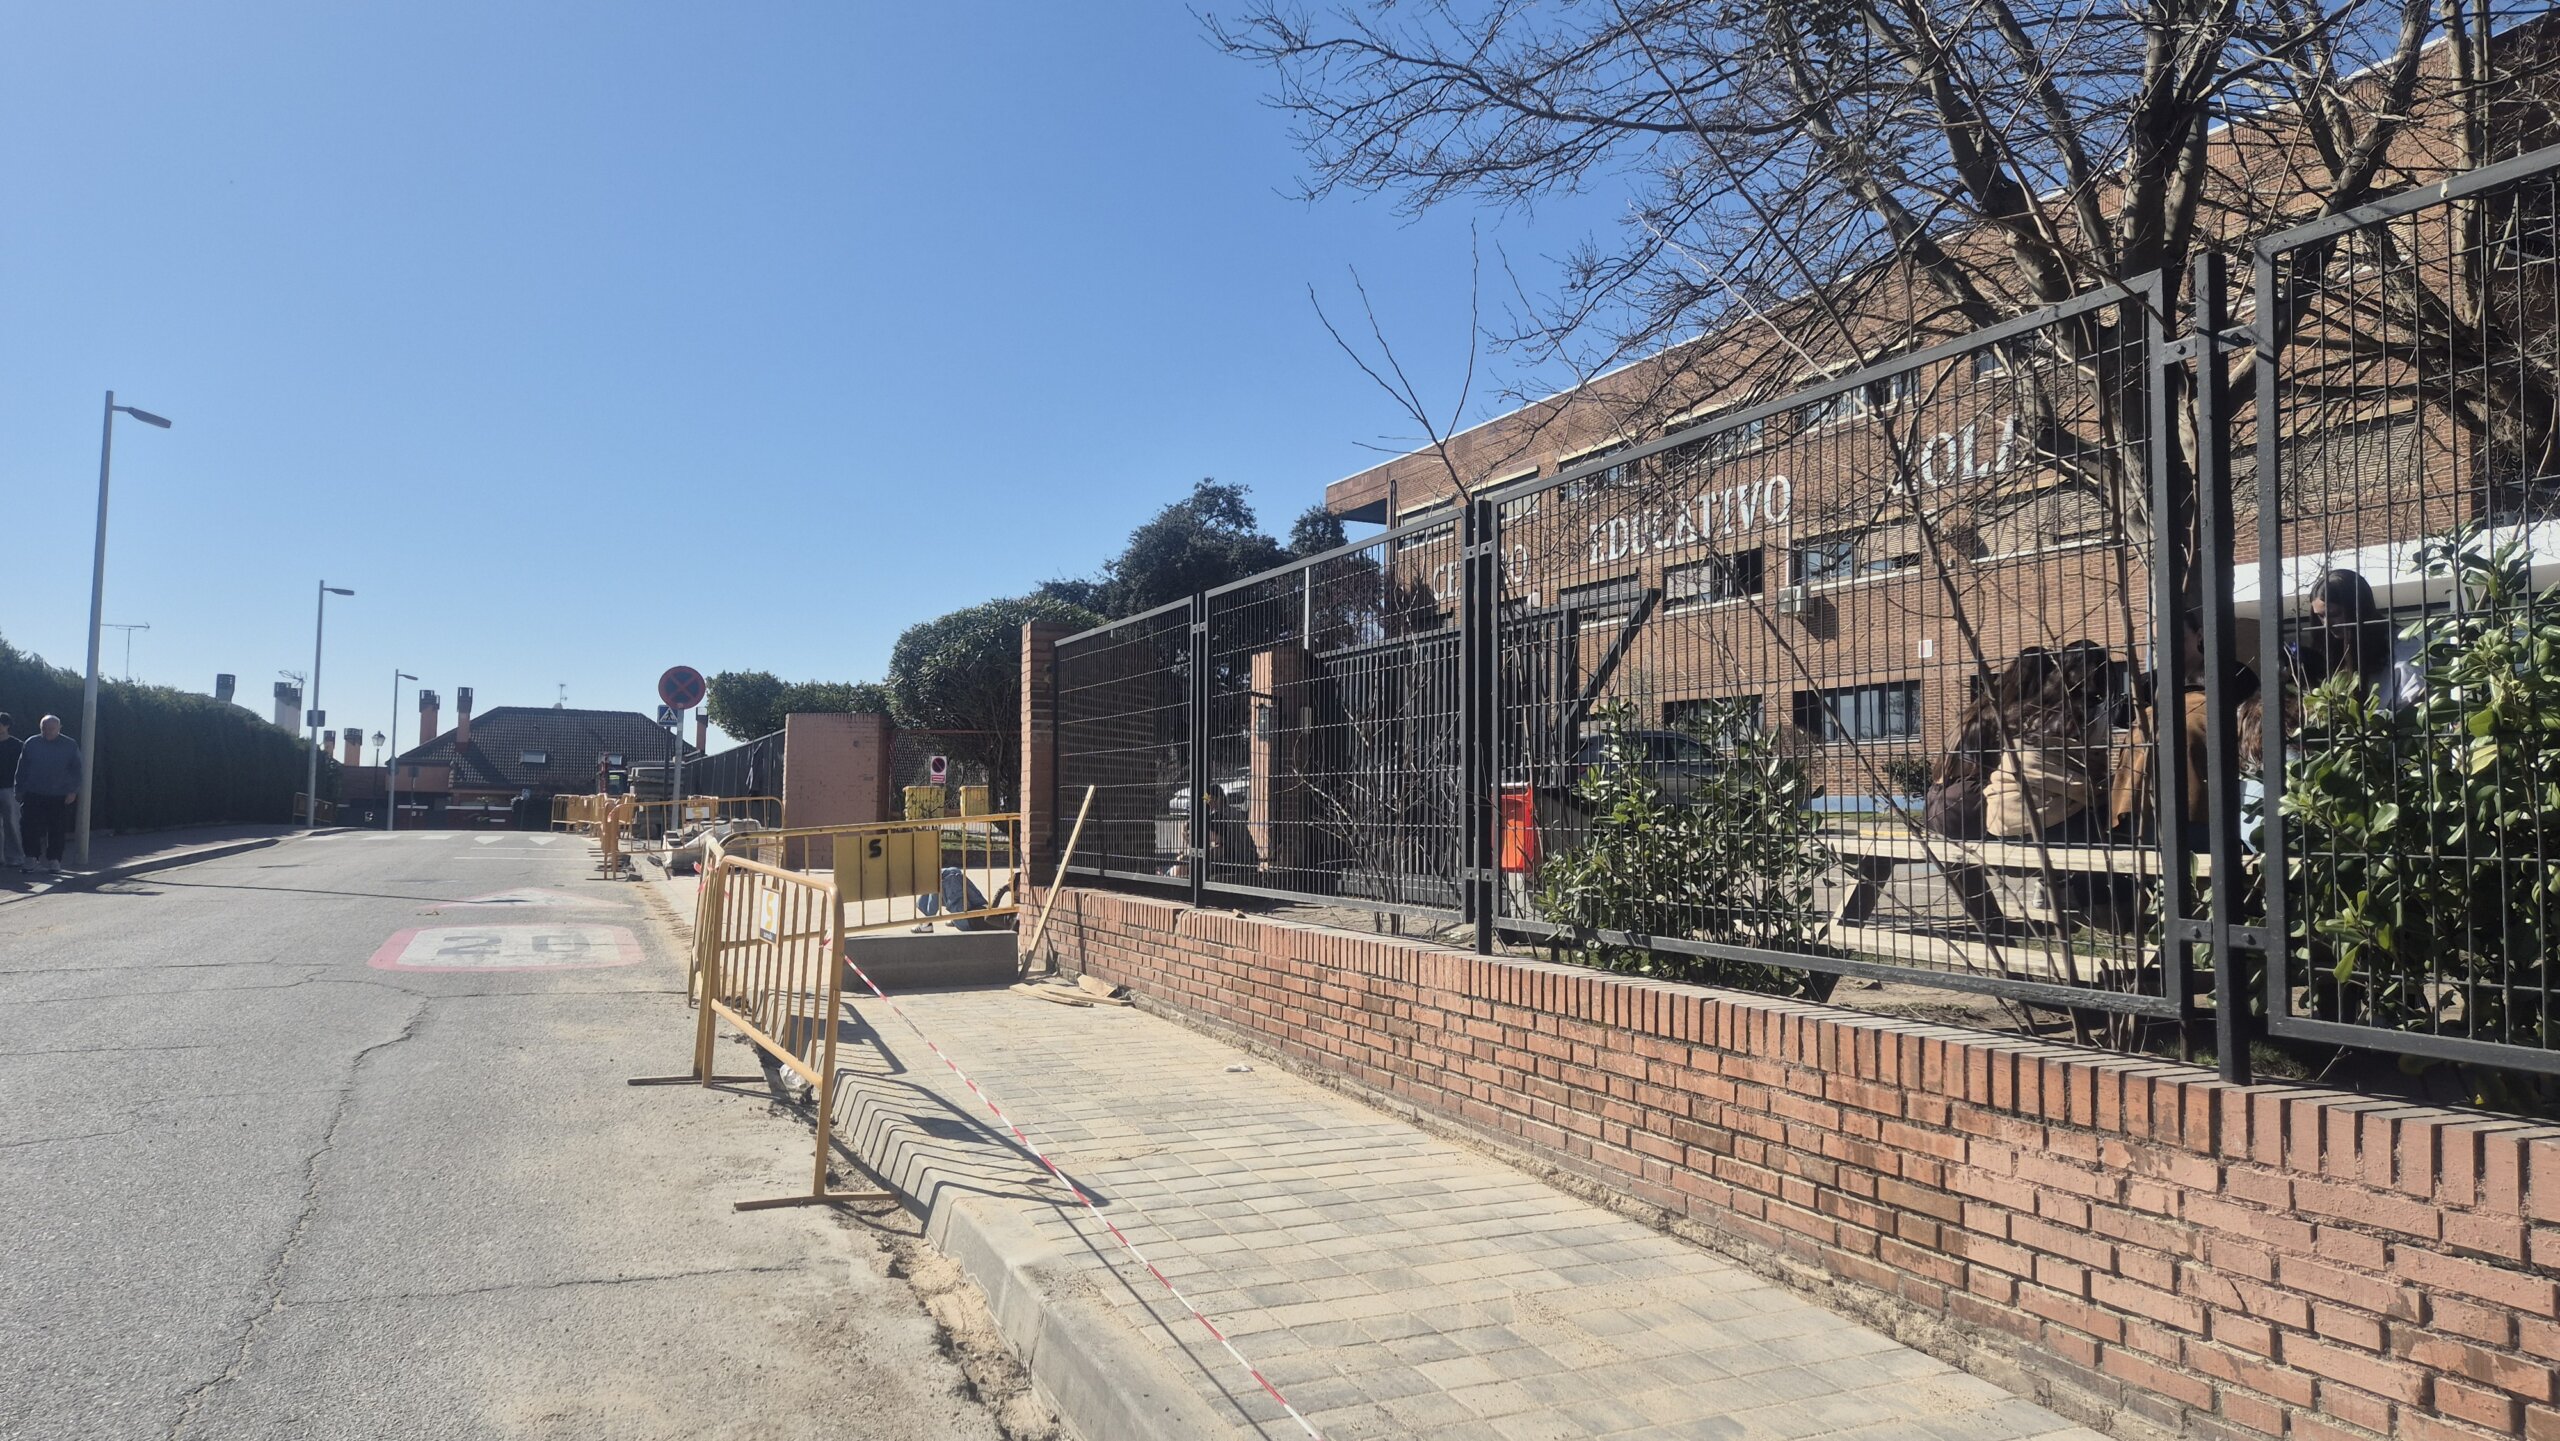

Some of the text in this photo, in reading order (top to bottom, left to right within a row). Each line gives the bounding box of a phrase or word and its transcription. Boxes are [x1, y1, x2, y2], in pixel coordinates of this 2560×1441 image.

[1433, 544, 1530, 601] CEO
[1589, 475, 1792, 565] EDUCATIVO
[868, 838, 882, 859] S
[436, 934, 592, 956] 20
